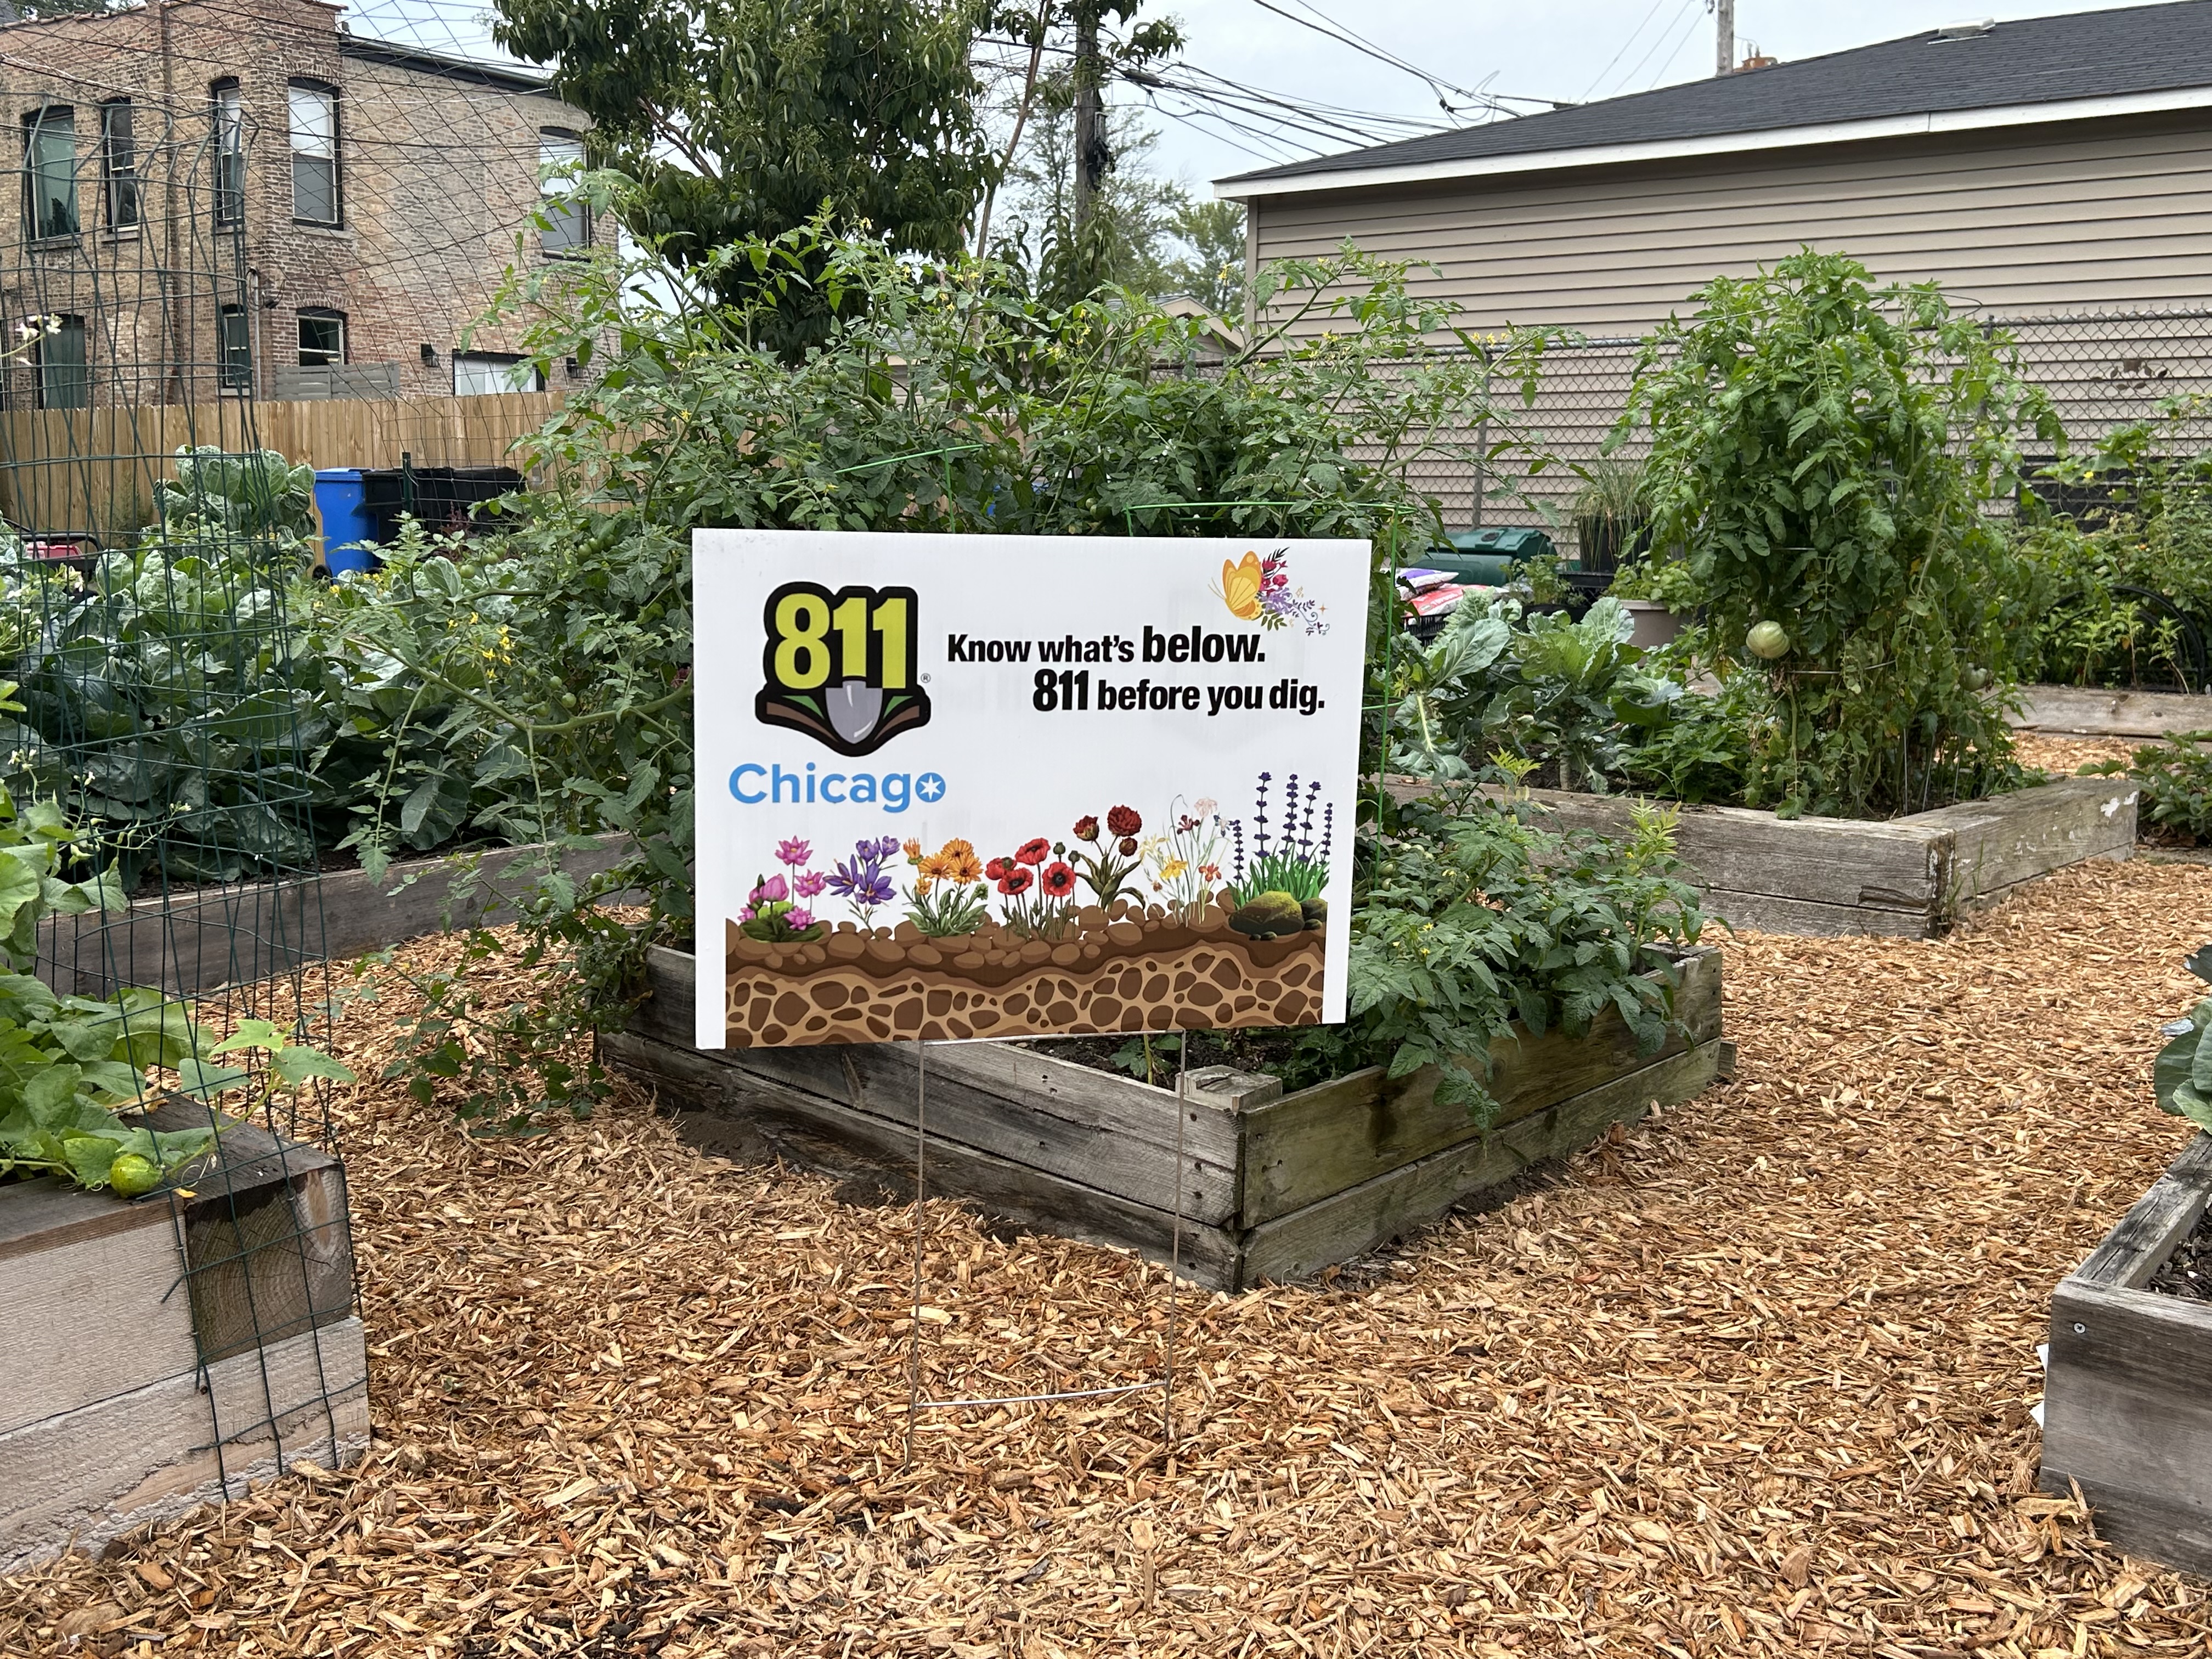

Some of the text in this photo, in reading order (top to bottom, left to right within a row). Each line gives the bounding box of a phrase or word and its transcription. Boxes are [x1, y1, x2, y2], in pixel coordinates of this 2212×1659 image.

[947, 625, 1265, 663] Know what’s below.
[1032, 669, 1325, 716] 811 before you dig.
[728, 761, 946, 814] Chicago
